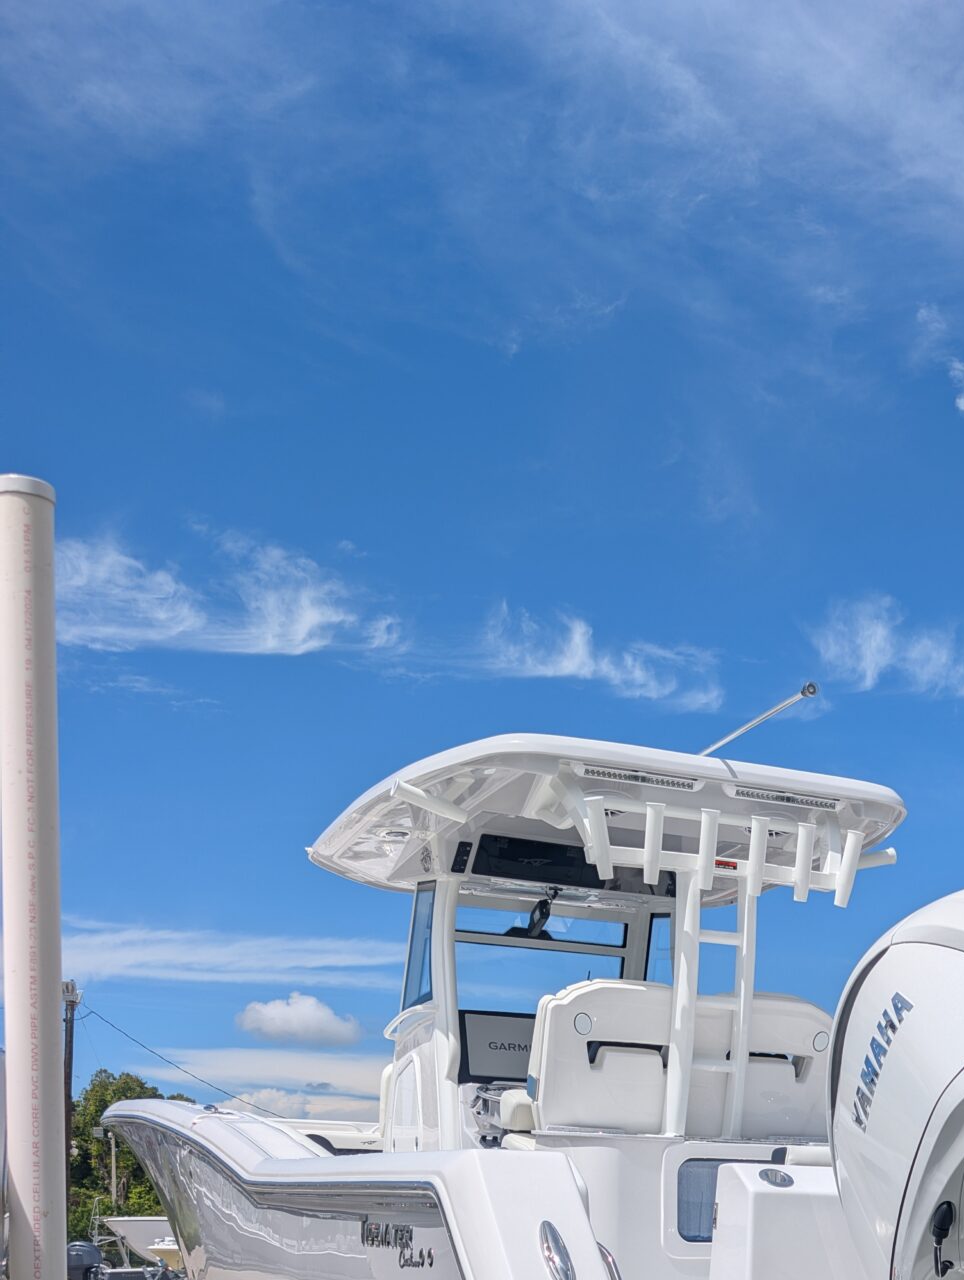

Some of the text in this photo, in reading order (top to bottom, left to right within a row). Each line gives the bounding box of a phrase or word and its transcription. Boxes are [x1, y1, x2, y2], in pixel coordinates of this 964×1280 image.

[24, 589, 33, 651] 04/17/2024
[24, 679, 34, 745] PRESSURE
[25, 749, 34, 774] FOR
[26, 778, 35, 803] NOT
[29, 975, 38, 1010] ASTM
[30, 1015, 39, 1040] PIPE
[31, 1042, 39, 1072] DWV
[488, 1041, 531, 1053] GARM
[852, 991, 914, 1134] YAMAHA
[31, 1076, 40, 1099] PVC
[31, 1103, 40, 1137] CORE
[32, 1141, 40, 1203] CELLULAR
